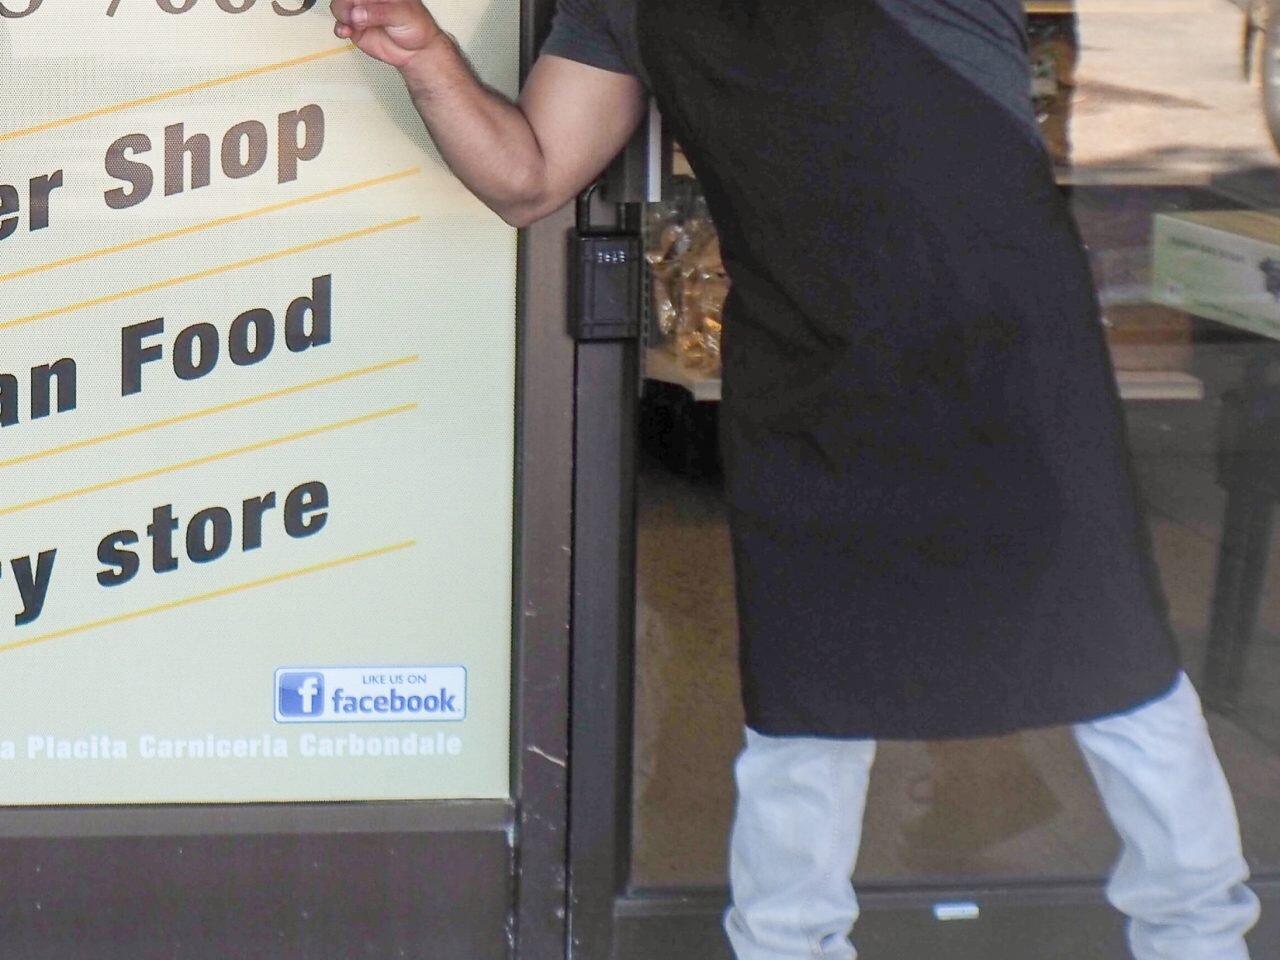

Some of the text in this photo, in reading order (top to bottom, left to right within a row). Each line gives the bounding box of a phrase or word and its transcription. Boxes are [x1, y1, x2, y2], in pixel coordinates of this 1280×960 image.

[103, 103, 325, 211] Shop
[120, 273, 333, 398] Food
[96, 478, 331, 589] store
[332, 688, 456, 714] facebook
[362, 674, 428, 685] LIKE US ON
[27, 733, 128, 759] Placita
[139, 732, 289, 759] Carniceria
[299, 731, 463, 758] Carbondale
